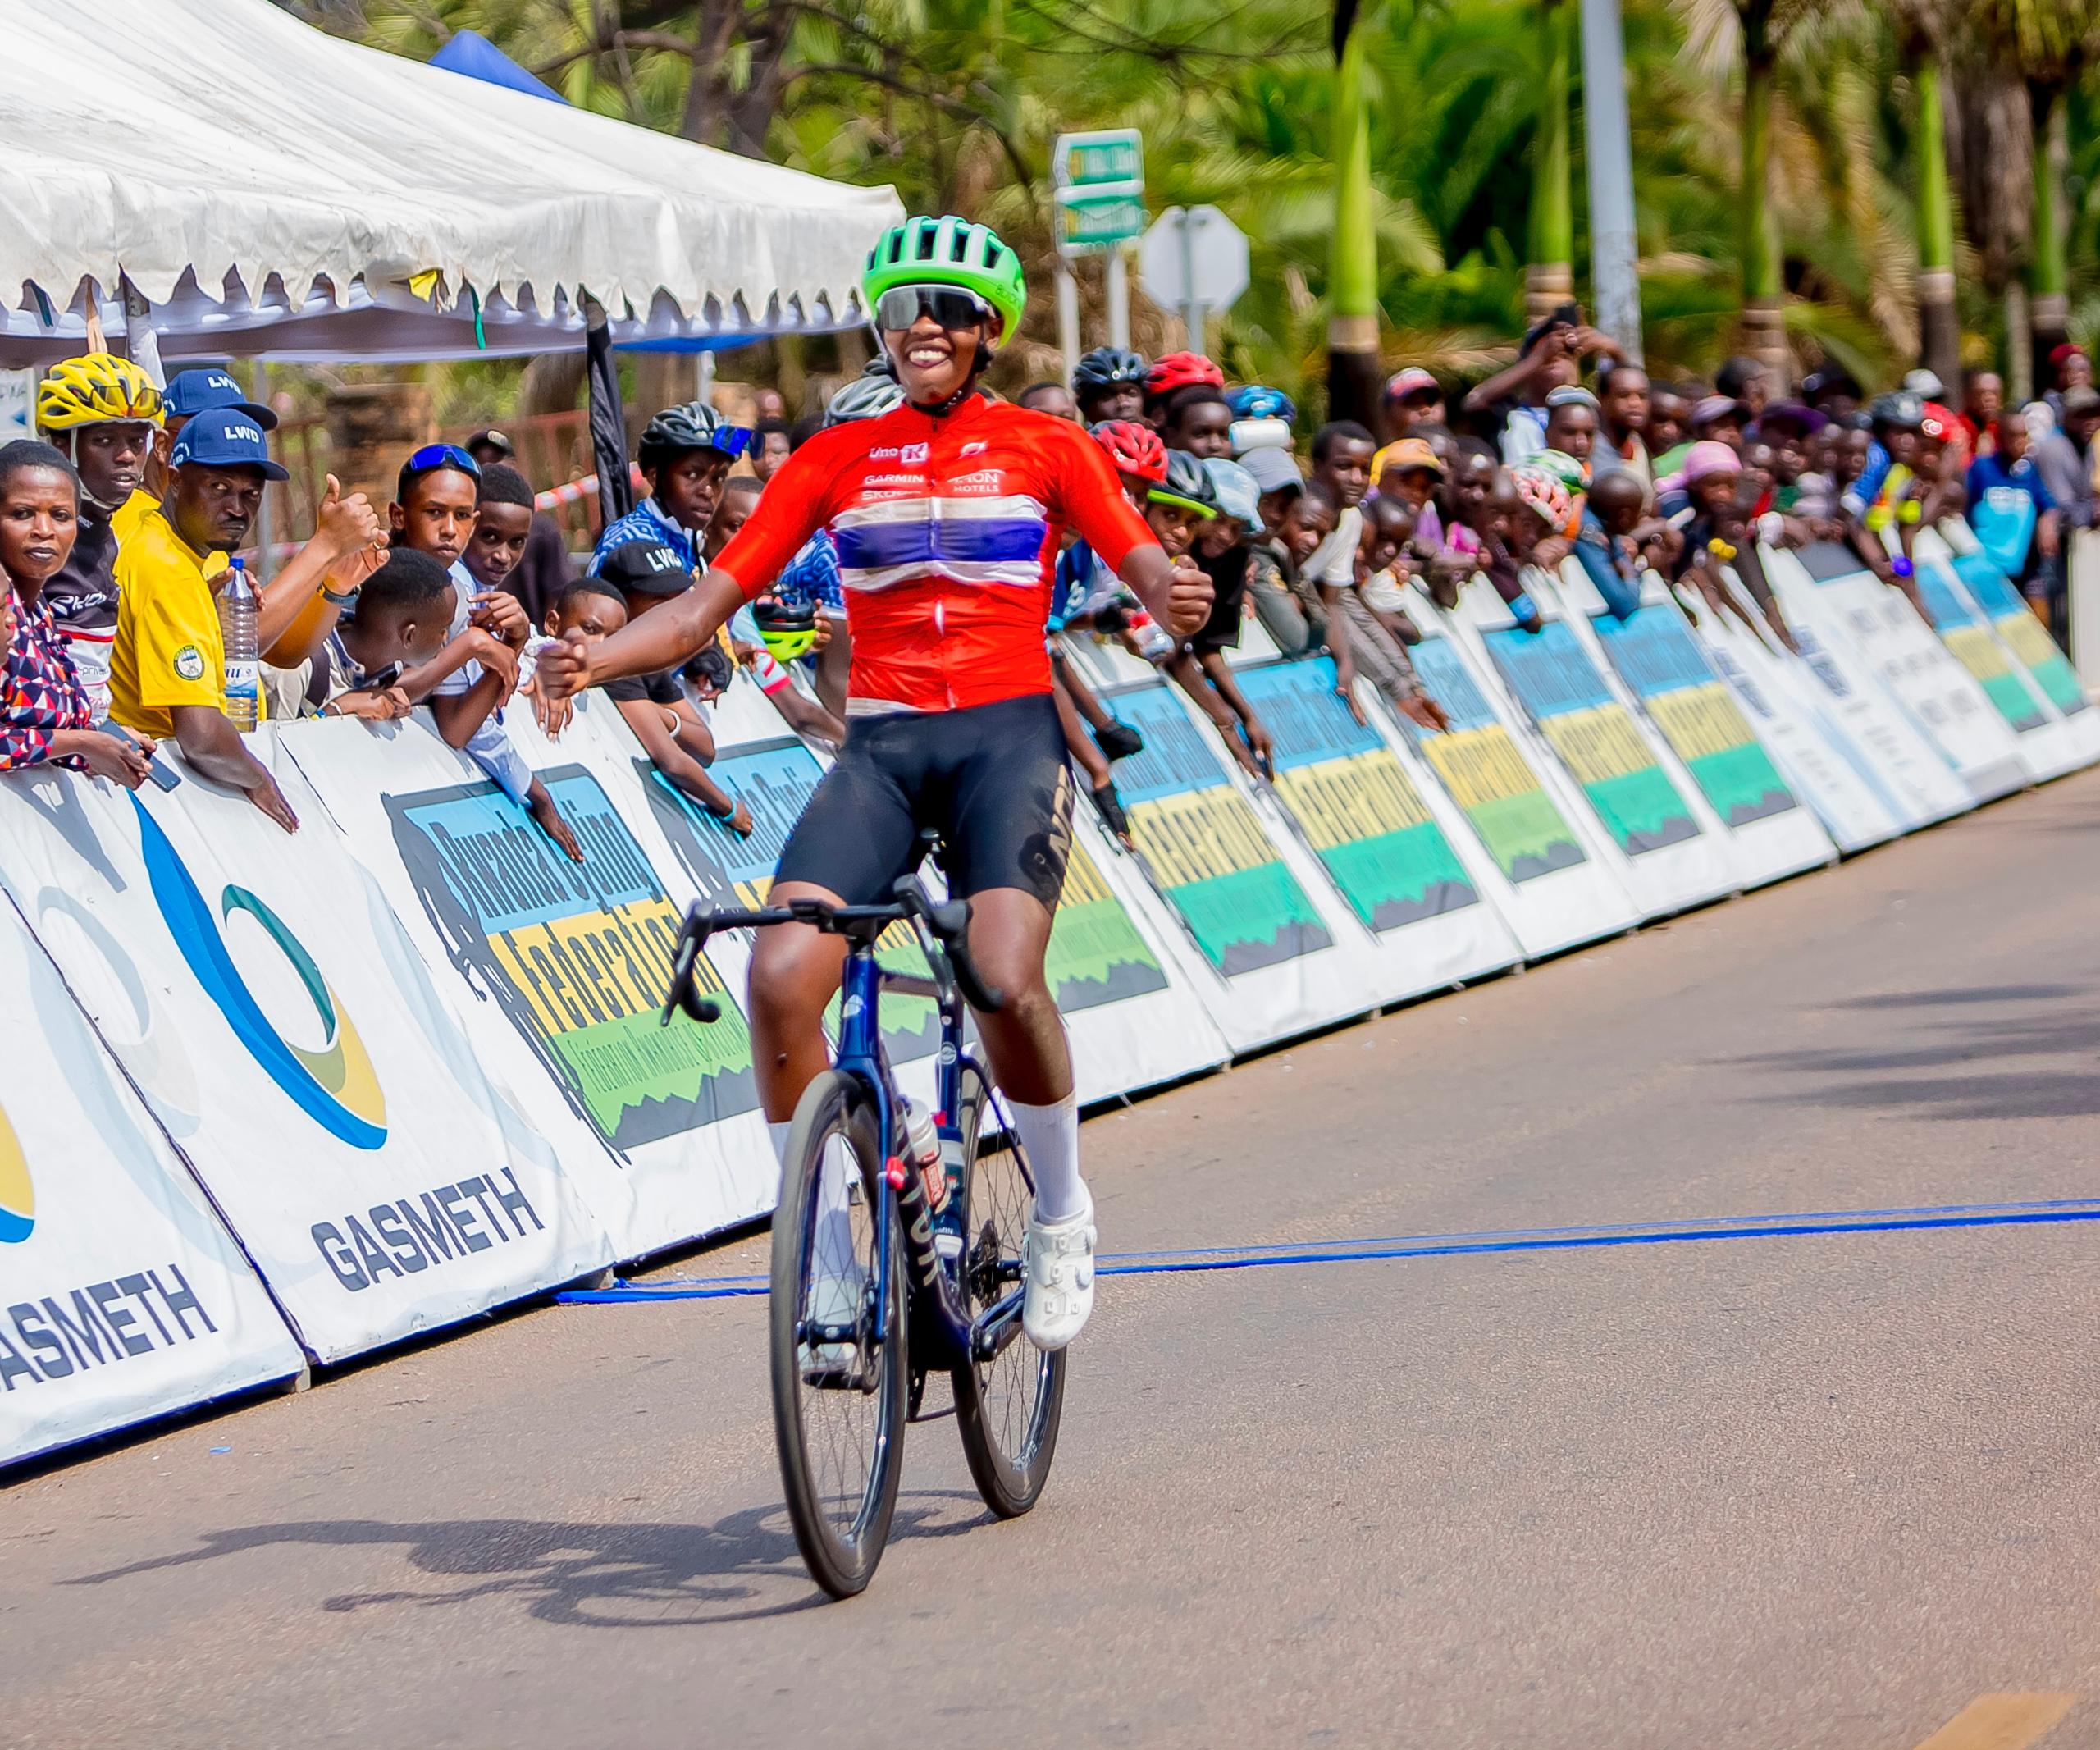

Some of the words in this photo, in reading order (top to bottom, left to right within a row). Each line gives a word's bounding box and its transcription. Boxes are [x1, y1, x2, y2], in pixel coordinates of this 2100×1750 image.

[224, 426, 259, 444] LWD
[865, 474, 924, 485] GARMIN
[428, 809, 572, 919] Rwanda
[311, 1167, 545, 1292] GASMETH
[0, 1263, 218, 1392] ASMETH
